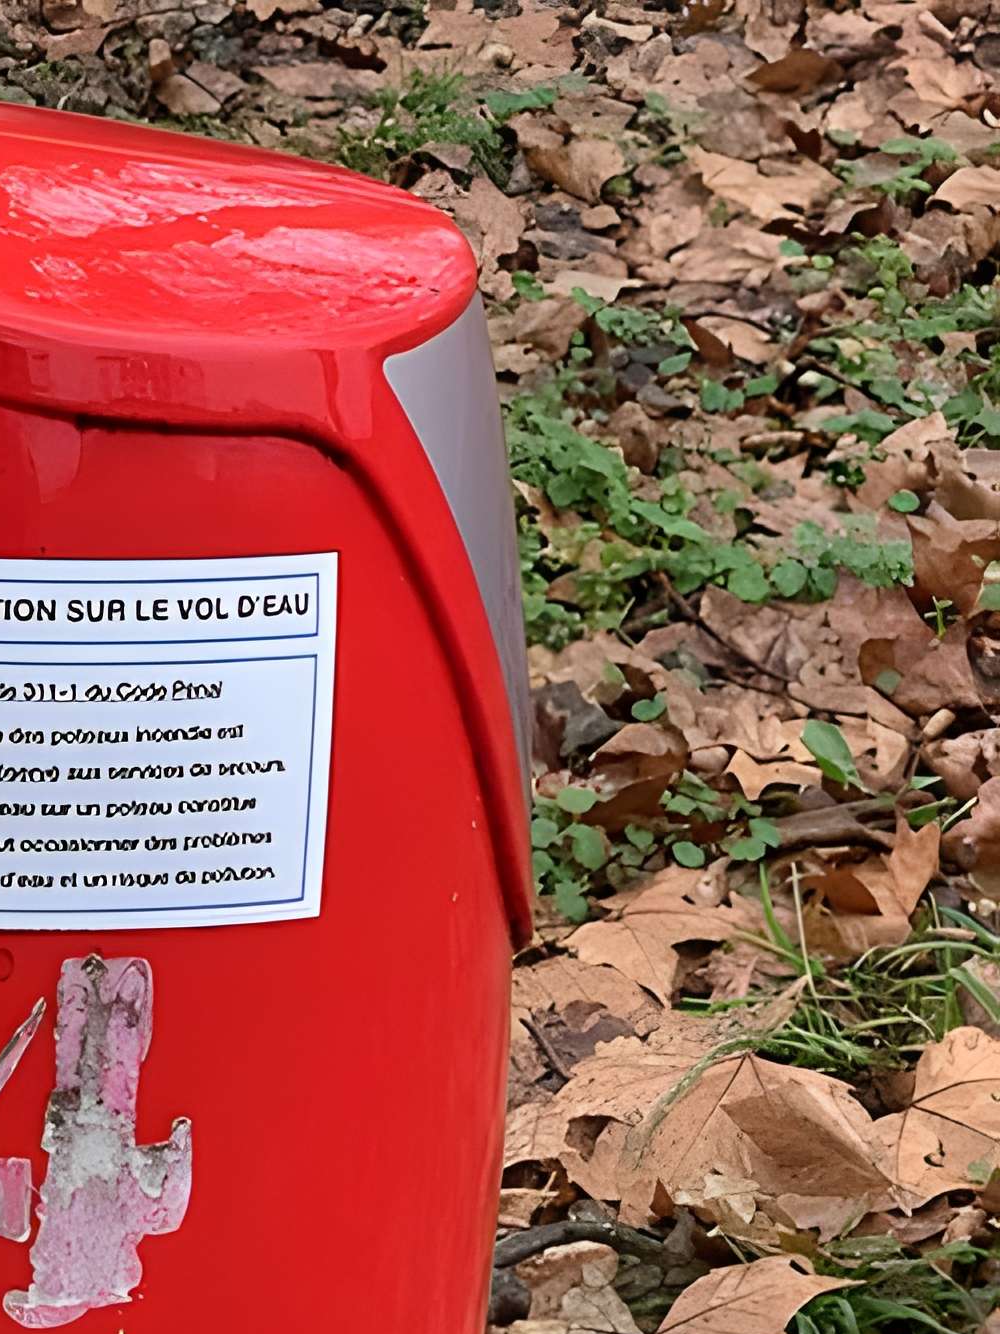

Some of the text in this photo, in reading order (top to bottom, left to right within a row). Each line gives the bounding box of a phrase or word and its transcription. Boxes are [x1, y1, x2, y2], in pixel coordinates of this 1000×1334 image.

[67, 600, 125, 622] SUR
[136, 600, 168, 621] LE
[177, 598, 228, 620] VOL
[238, 593, 308, 617] D'EAU
